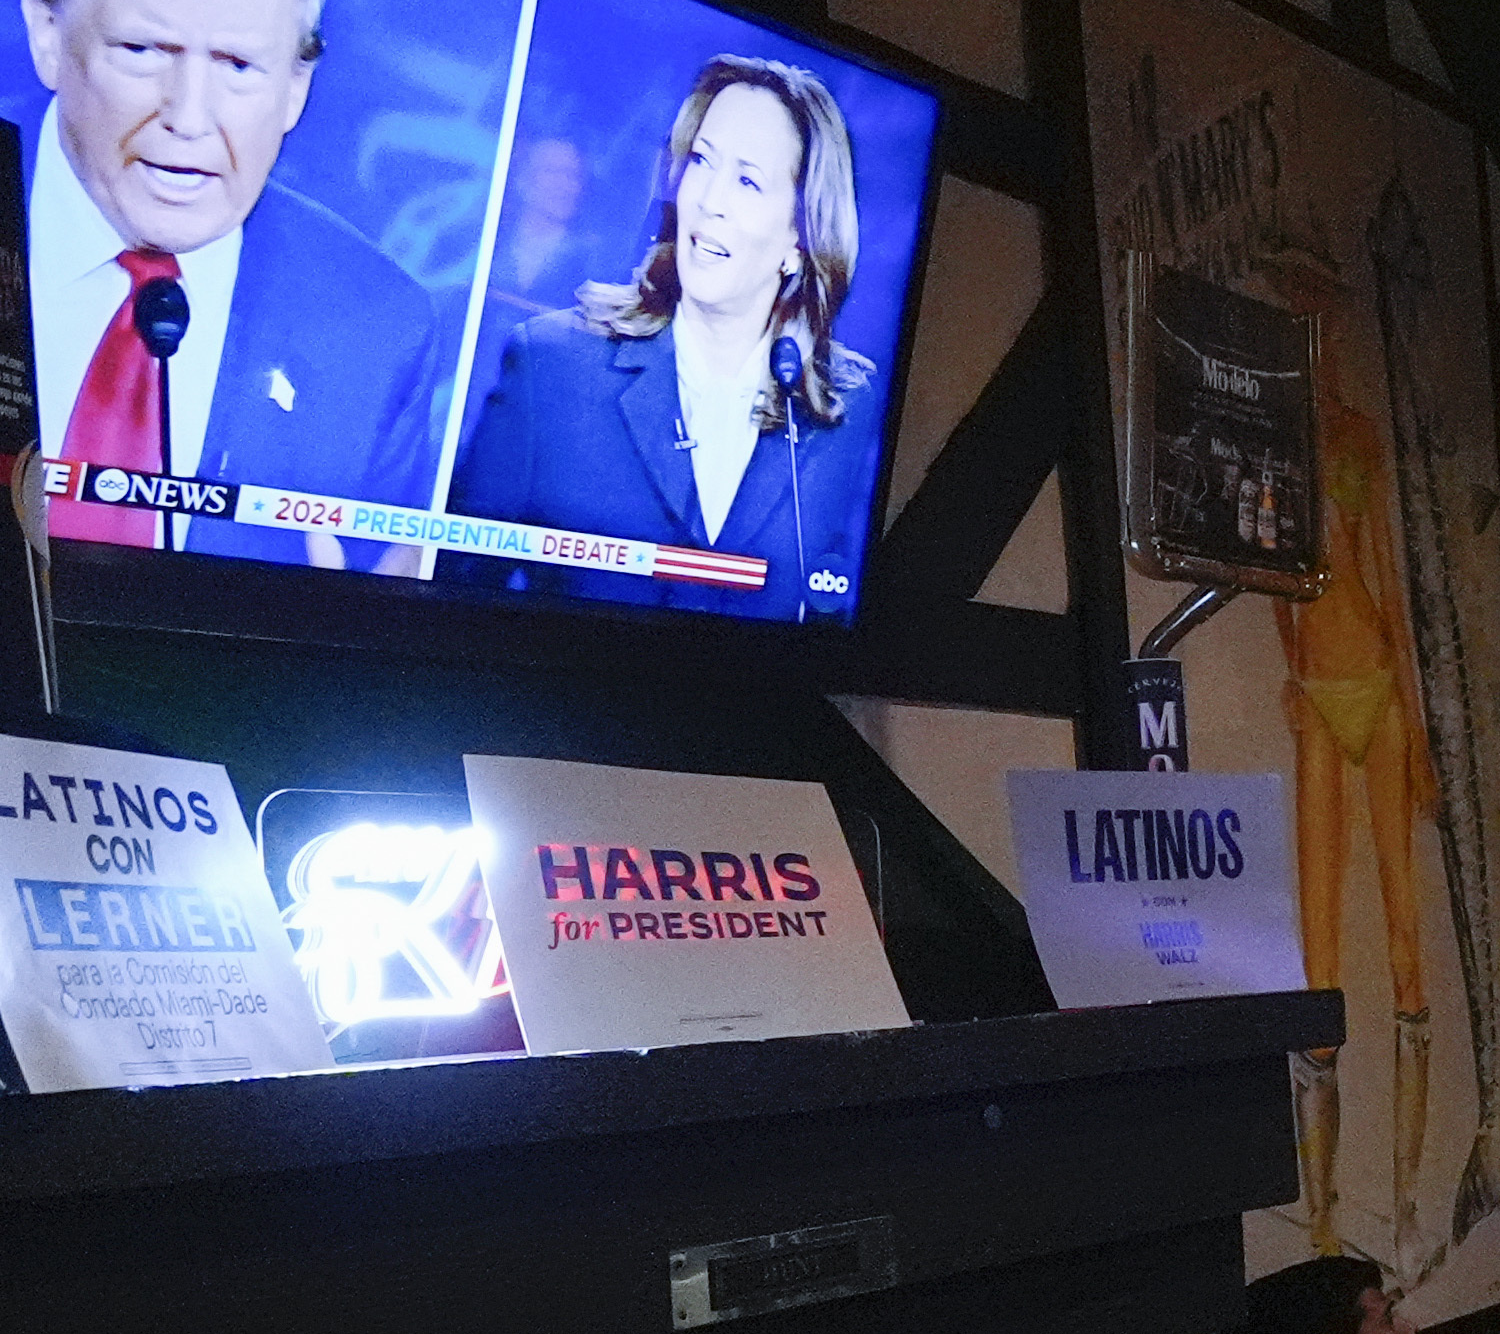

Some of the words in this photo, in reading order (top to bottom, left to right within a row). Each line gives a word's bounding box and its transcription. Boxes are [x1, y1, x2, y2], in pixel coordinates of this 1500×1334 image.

[127, 476, 229, 514] NEWS
[275, 497, 343, 527] 2024
[353, 508, 532, 553] PRESIDENTIAL
[543, 535, 629, 565] DEBATE
[808, 568, 850, 595] abc
[86, 834, 156, 875] CON
[1064, 808, 1244, 884] LATINOS
[537, 844, 821, 901] HARRIS
[23, 886, 252, 949] LERNER
[548, 911, 600, 950] for
[608, 911, 828, 940] PRESIDENT
[57, 962, 103, 990] para
[107, 963, 124, 986] la
[126, 957, 214, 985] Comisión
[221, 959, 248, 984] del
[1156, 949, 1199, 965] WALZ
[60, 990, 155, 1019] Condado
[160, 988, 268, 1016] Miami-Dade
[137, 1021, 204, 1050] Distrito
[205, 1020, 217, 1048] 7
